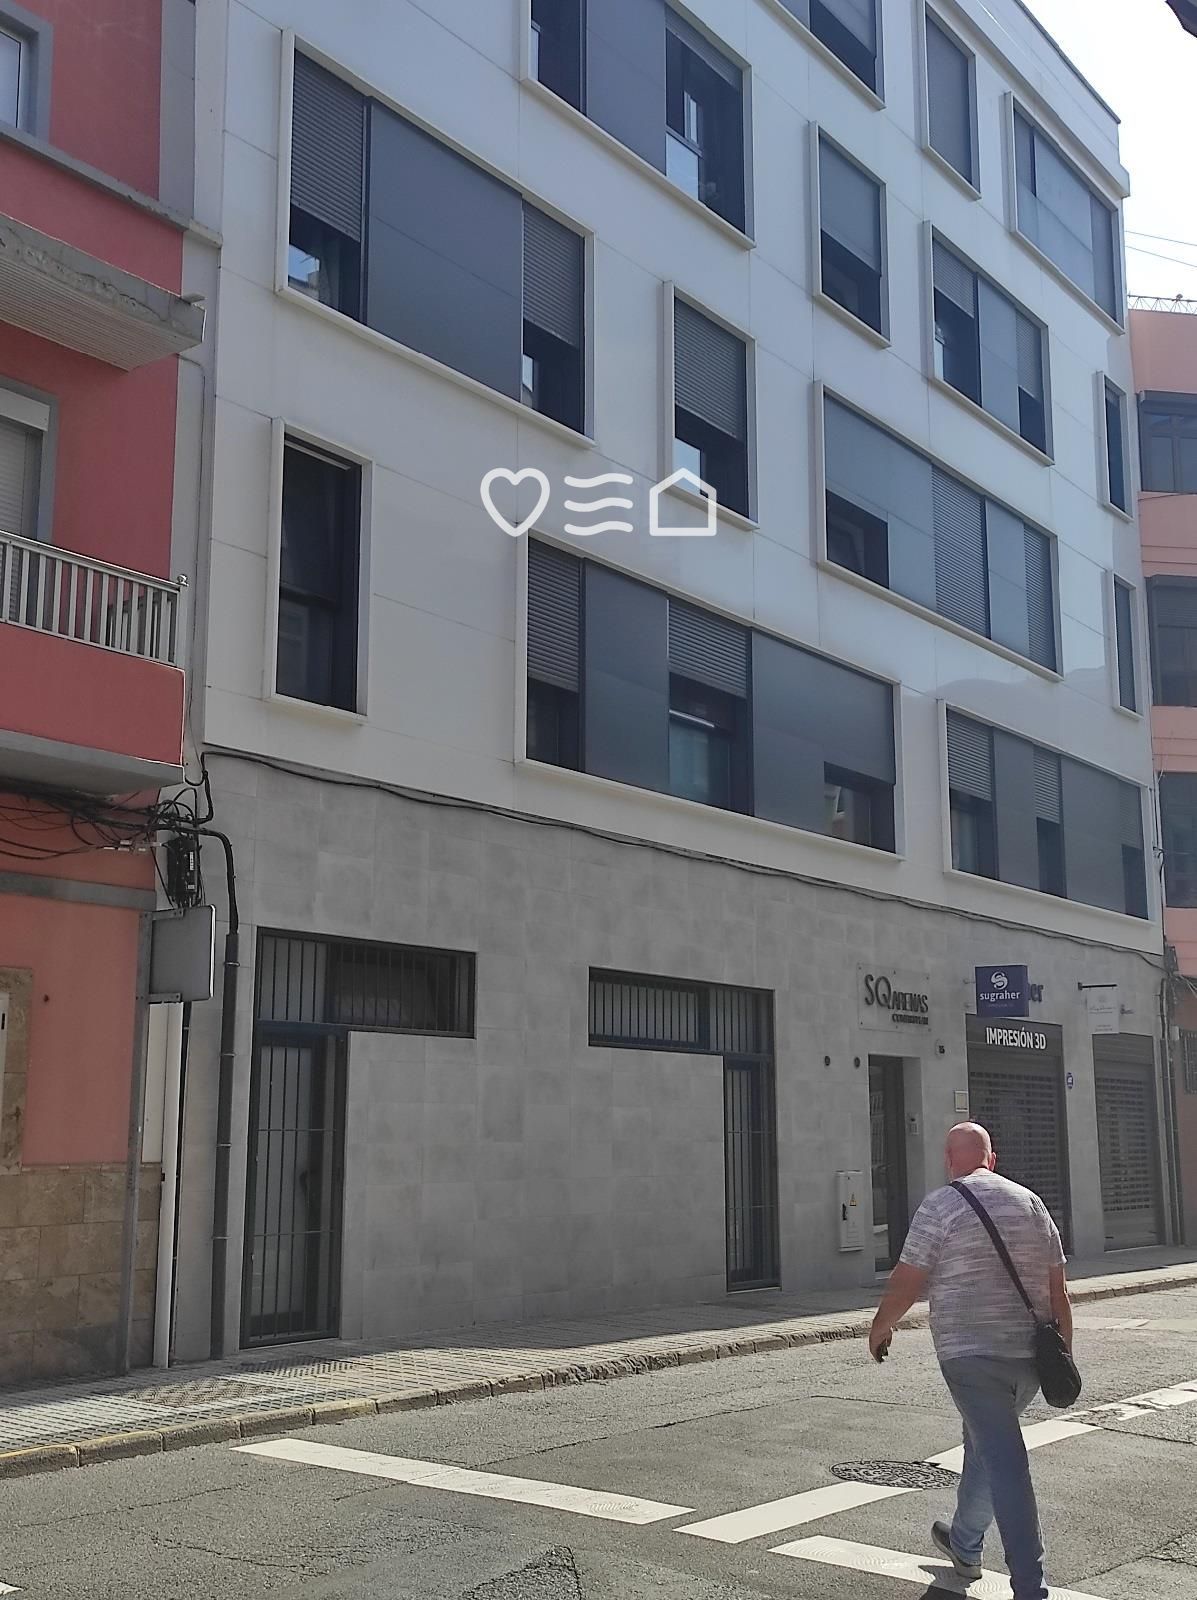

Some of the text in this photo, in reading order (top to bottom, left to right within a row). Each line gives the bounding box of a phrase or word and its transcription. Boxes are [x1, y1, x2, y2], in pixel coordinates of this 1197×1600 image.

[979, 990, 1021, 1003] sugraher
[986, 1026, 1047, 1050] IMPRESIÓN 3D
